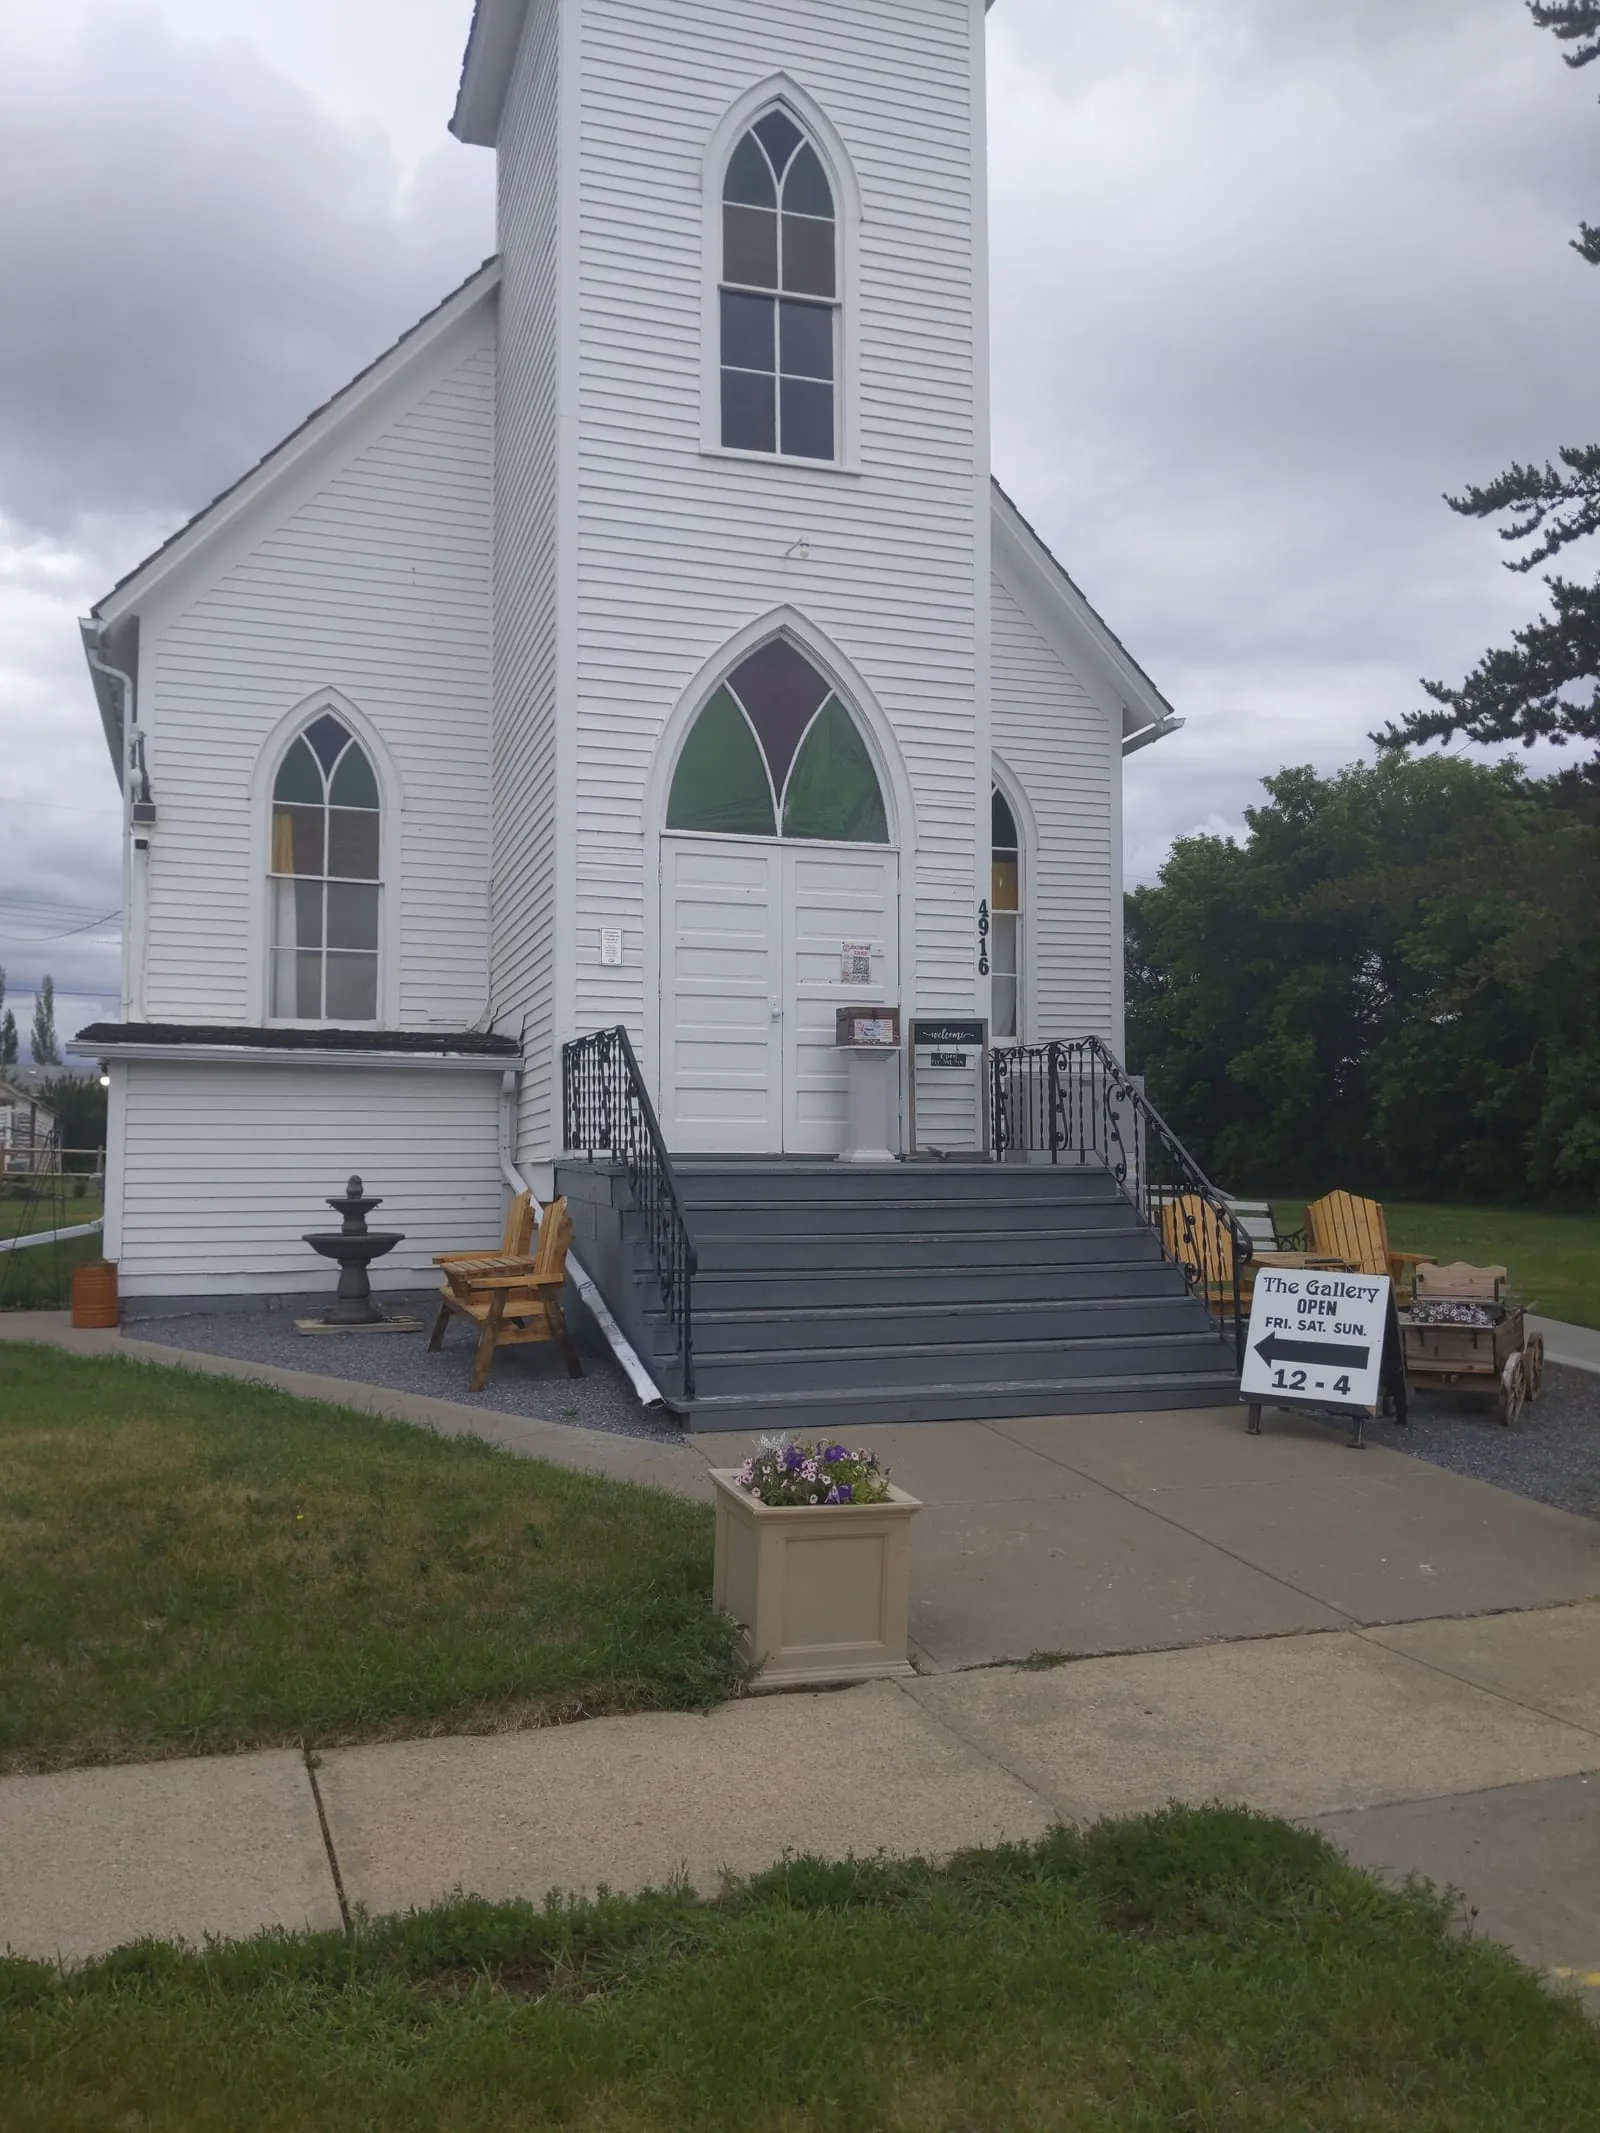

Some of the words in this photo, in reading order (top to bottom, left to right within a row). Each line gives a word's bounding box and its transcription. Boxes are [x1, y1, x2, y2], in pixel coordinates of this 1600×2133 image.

[978, 898, 989, 976] 4916
[923, 1027, 974, 1040] welcome
[1263, 1276, 1299, 1294] The
[1306, 1279, 1380, 1304] Gallery
[1297, 1298, 1338, 1316] OPEN
[1265, 1316, 1292, 1329] FRI.
[1297, 1319, 1326, 1333] SAT.
[1333, 1322, 1367, 1336] SUN.
[1271, 1368, 1307, 1391] 12
[1332, 1375, 1351, 1396] 4
